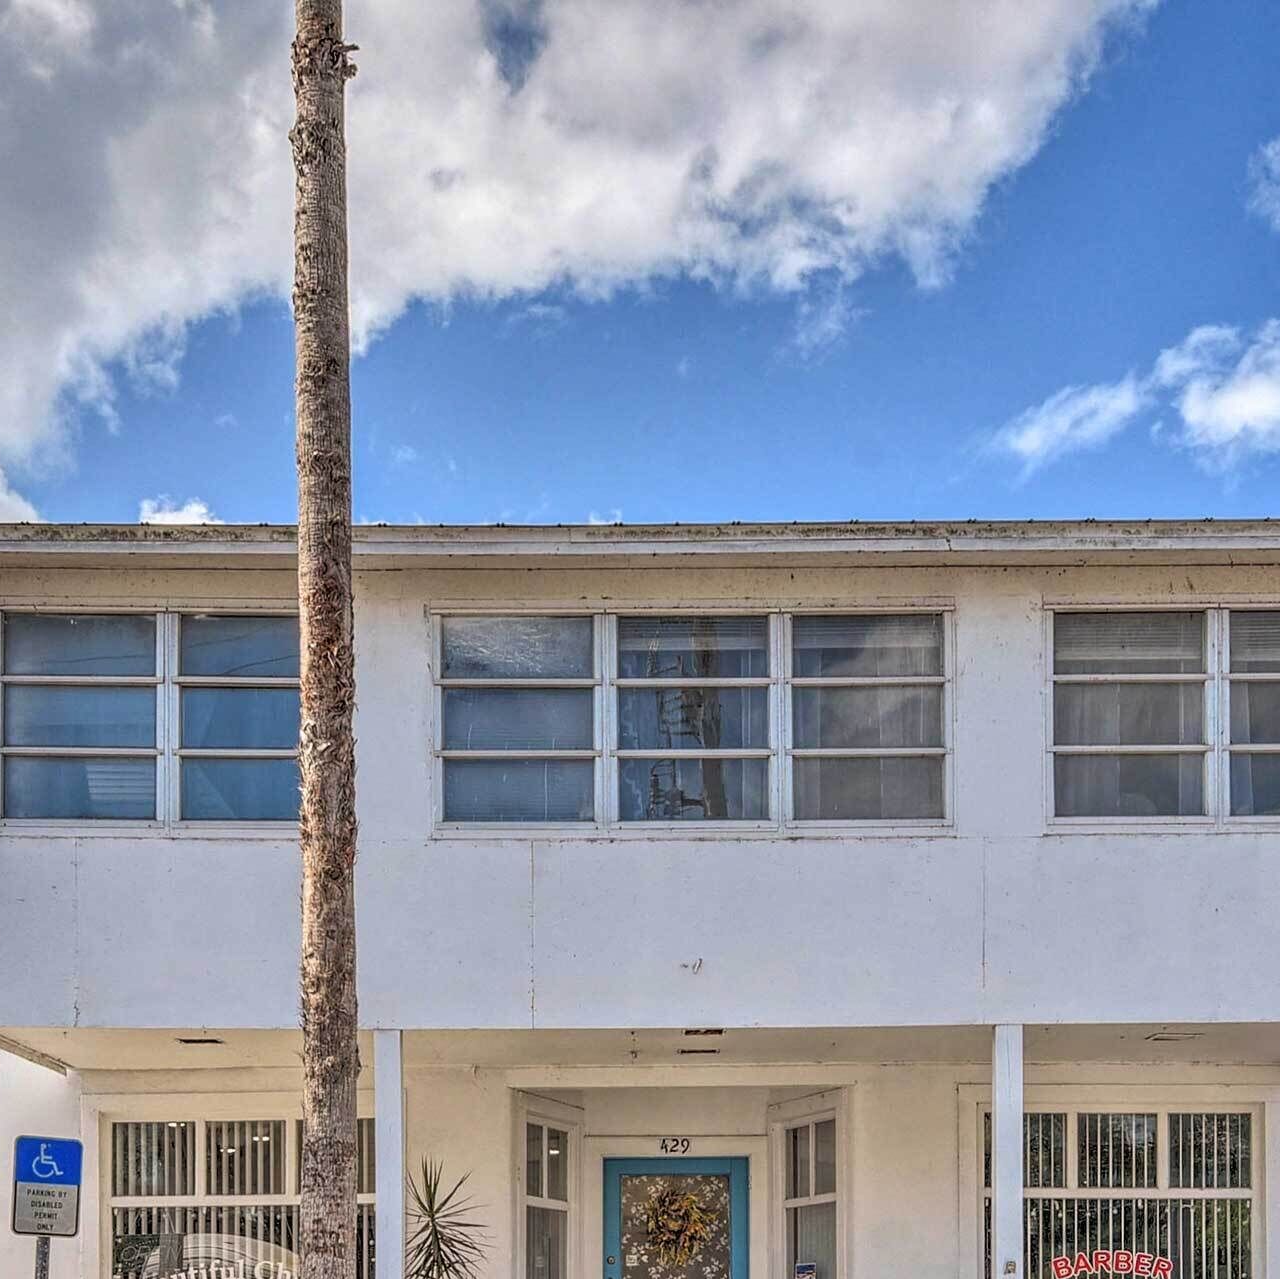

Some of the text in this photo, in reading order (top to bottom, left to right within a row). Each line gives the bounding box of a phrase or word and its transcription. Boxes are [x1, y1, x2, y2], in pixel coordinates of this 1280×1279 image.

[660, 1138, 690, 1154] 429
[27, 1188, 56, 1197] PARKING
[30, 1200, 63, 1209] DISABLED
[34, 1211, 58, 1220] PERMIT
[37, 1223, 54, 1231] ONLY
